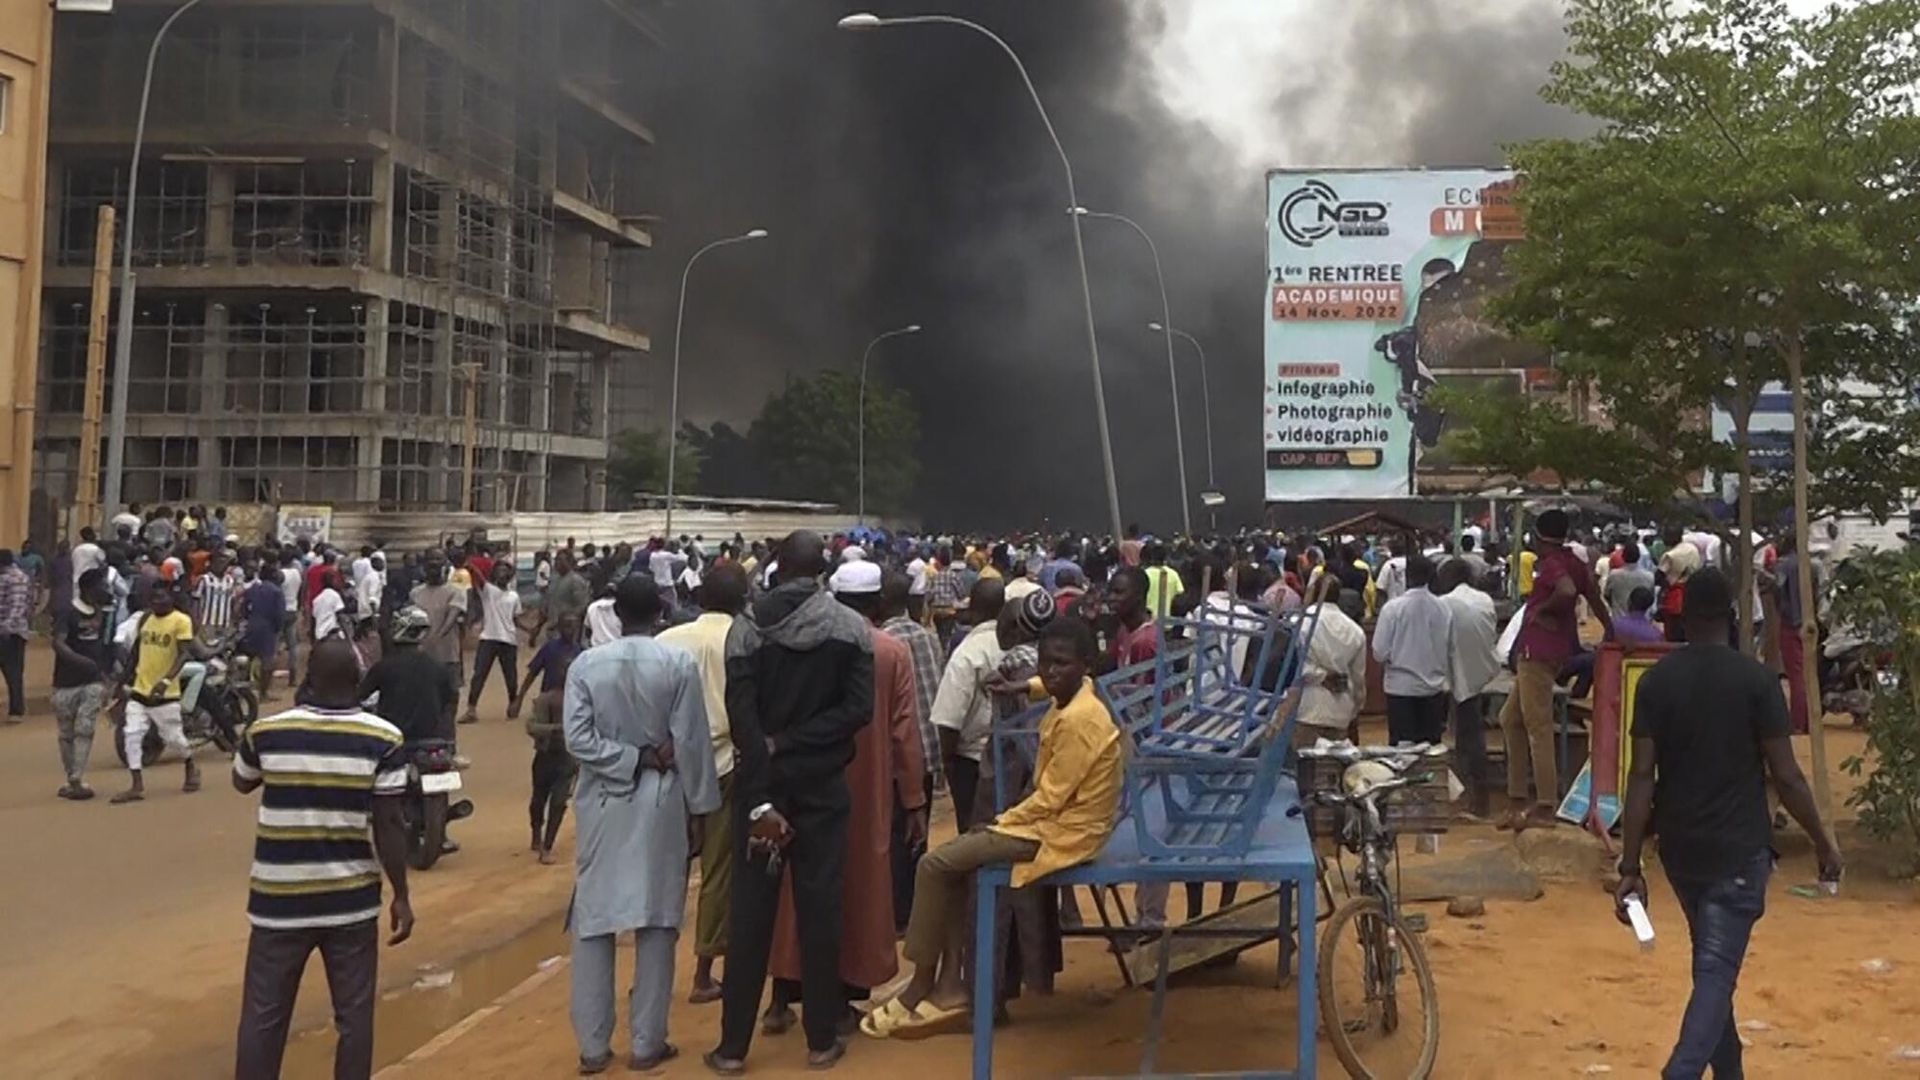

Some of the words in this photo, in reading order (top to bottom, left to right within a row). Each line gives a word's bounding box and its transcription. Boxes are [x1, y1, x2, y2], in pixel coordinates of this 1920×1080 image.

[1308, 263, 1402, 282] RENTREE
[1275, 288, 1399, 304] ACADEMIQUE
[1279, 306, 1298, 318] 14
[1307, 306, 1347, 318] Nov.
[1355, 305, 1398, 318] 2022
[1277, 380, 1375, 400] Infographie
[1277, 402, 1393, 422] Photographie
[1277, 425, 1389, 445] vidéographie
